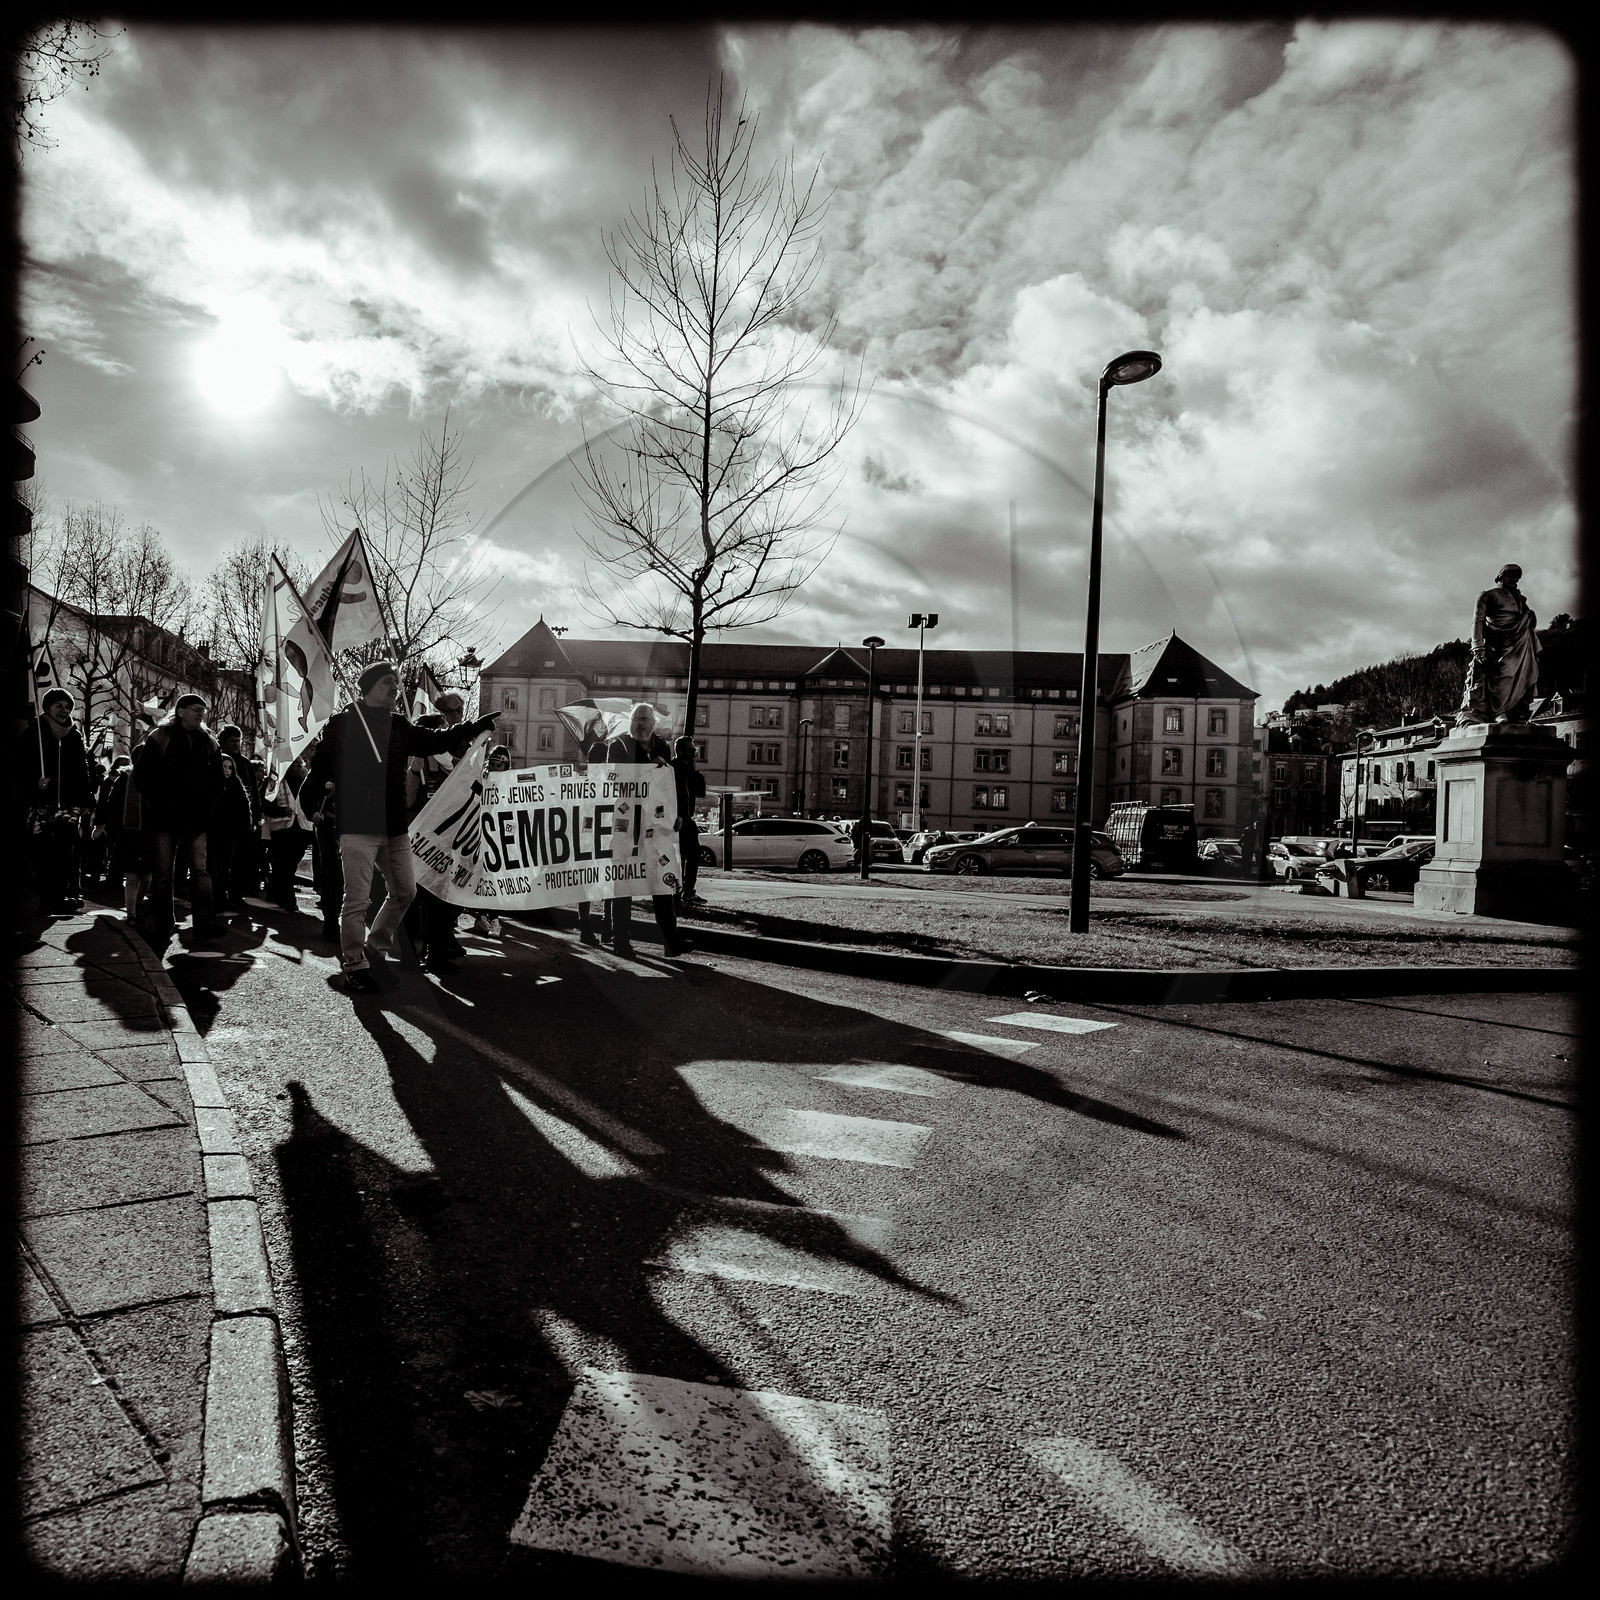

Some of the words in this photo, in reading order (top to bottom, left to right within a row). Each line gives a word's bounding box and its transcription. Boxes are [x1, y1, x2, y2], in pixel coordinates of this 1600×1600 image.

[507, 785, 545, 804] JEUNES
[560, 778, 597, 800] PRIVÉS
[410, 831, 455, 874] SALAIRES
[496, 875, 537, 896] PUBLICS
[544, 866, 600, 891] PROTECTION
[604, 862, 647, 881] SOCIALE
[481, 803, 615, 873] SEMBLE
